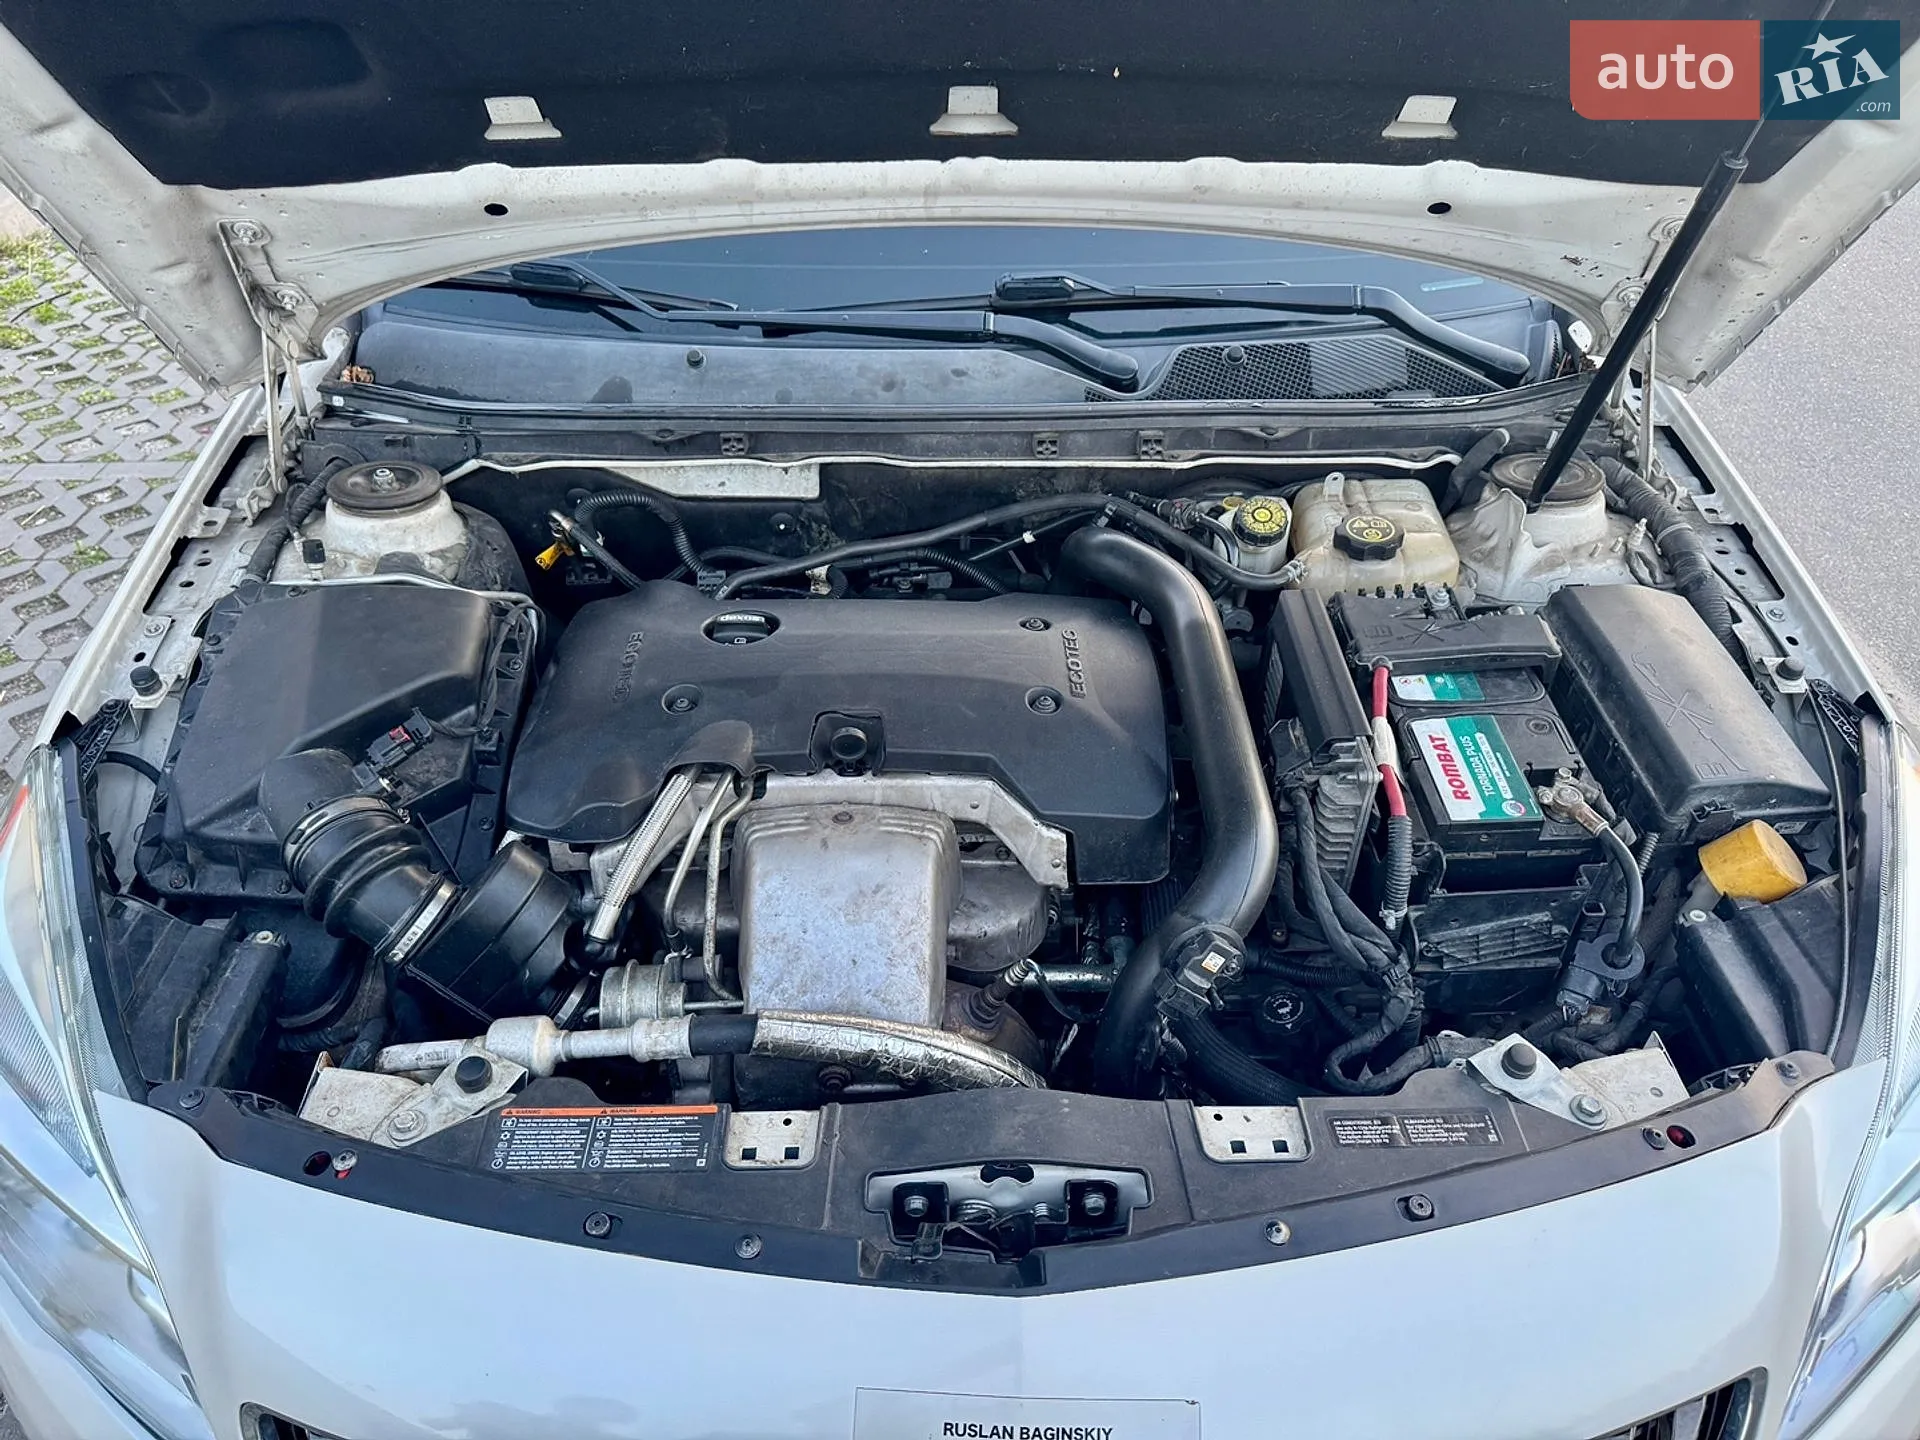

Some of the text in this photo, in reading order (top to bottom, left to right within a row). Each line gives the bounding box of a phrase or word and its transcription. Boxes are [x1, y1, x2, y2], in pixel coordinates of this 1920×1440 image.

[1062, 628, 1087, 699] ECOTEC
[1428, 734, 1472, 801] ROMBAT
[1459, 735, 1477, 757] PLUS
[943, 1422, 1113, 1440] RUSLAN BAGINSKIY
